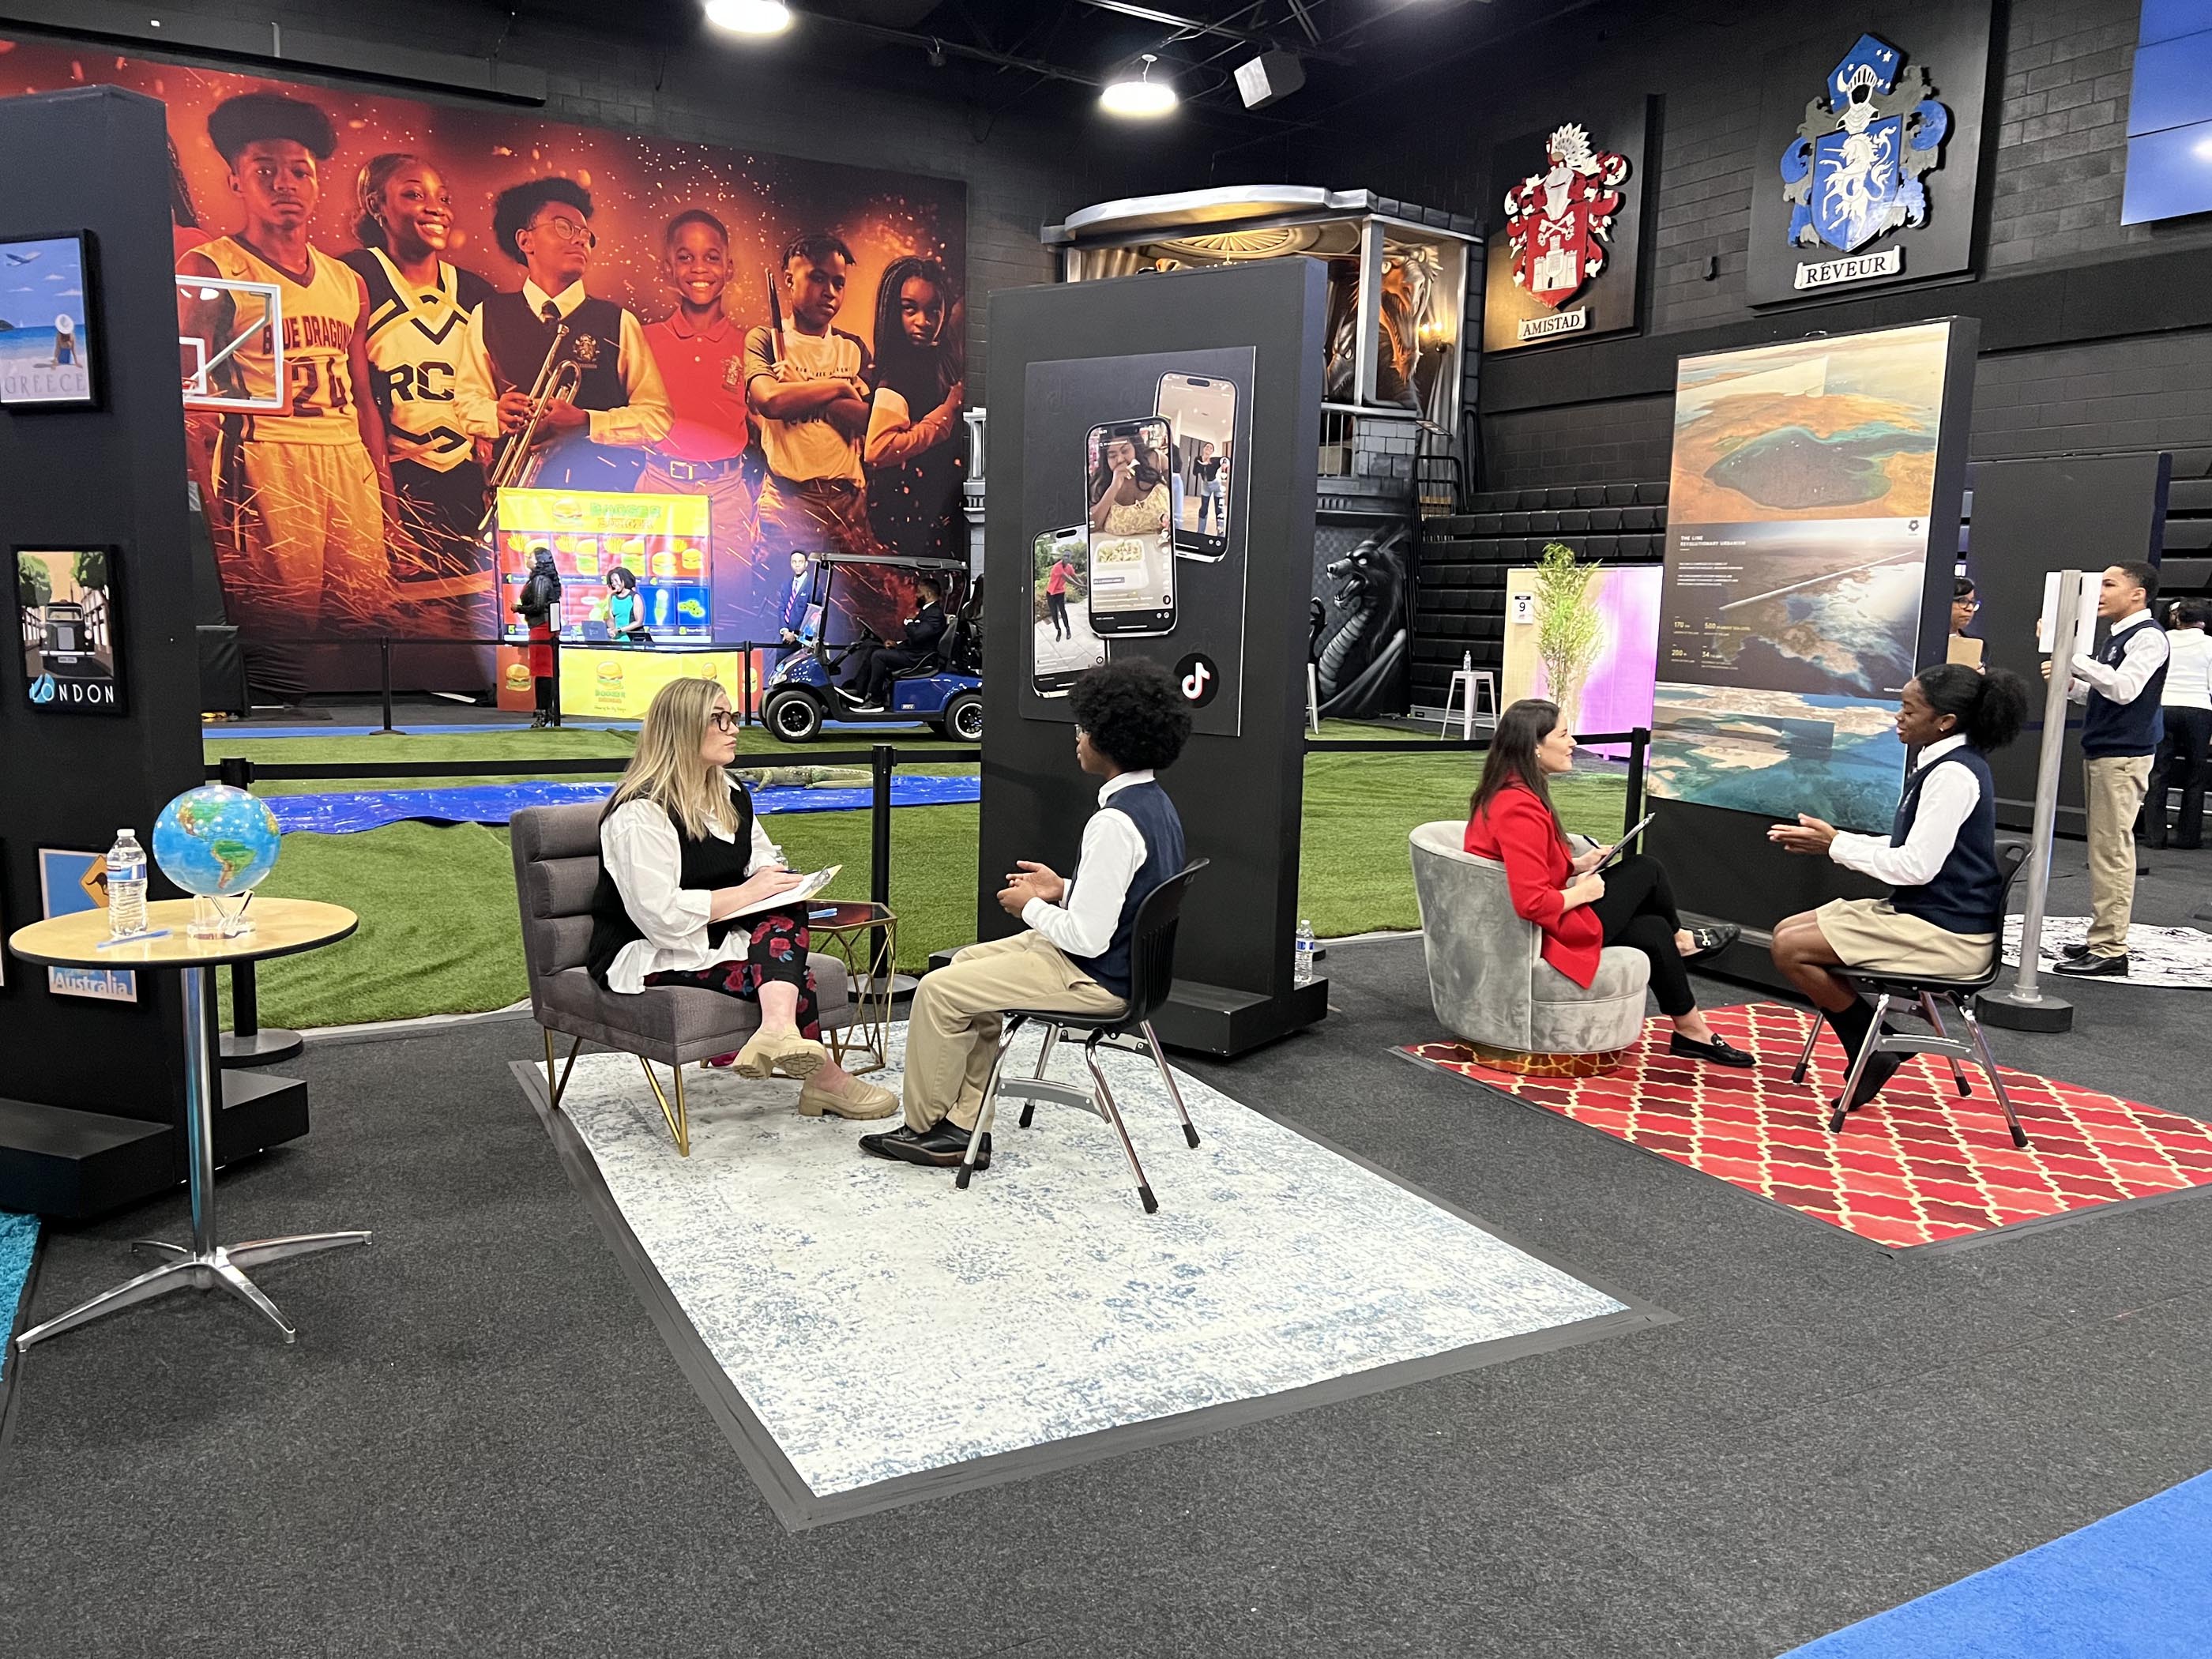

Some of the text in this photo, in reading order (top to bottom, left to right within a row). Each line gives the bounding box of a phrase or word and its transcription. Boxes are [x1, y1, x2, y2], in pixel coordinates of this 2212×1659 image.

[1806, 256, 1887, 284] RÊVEUR
[263, 318, 300, 355] BUE
[1522, 314, 1580, 337] AMISTAD
[389, 361, 454, 401] RC
[1519, 601, 1525, 612] 9
[31, 683, 115, 703] LONDON
[55, 971, 128, 995] Australia
